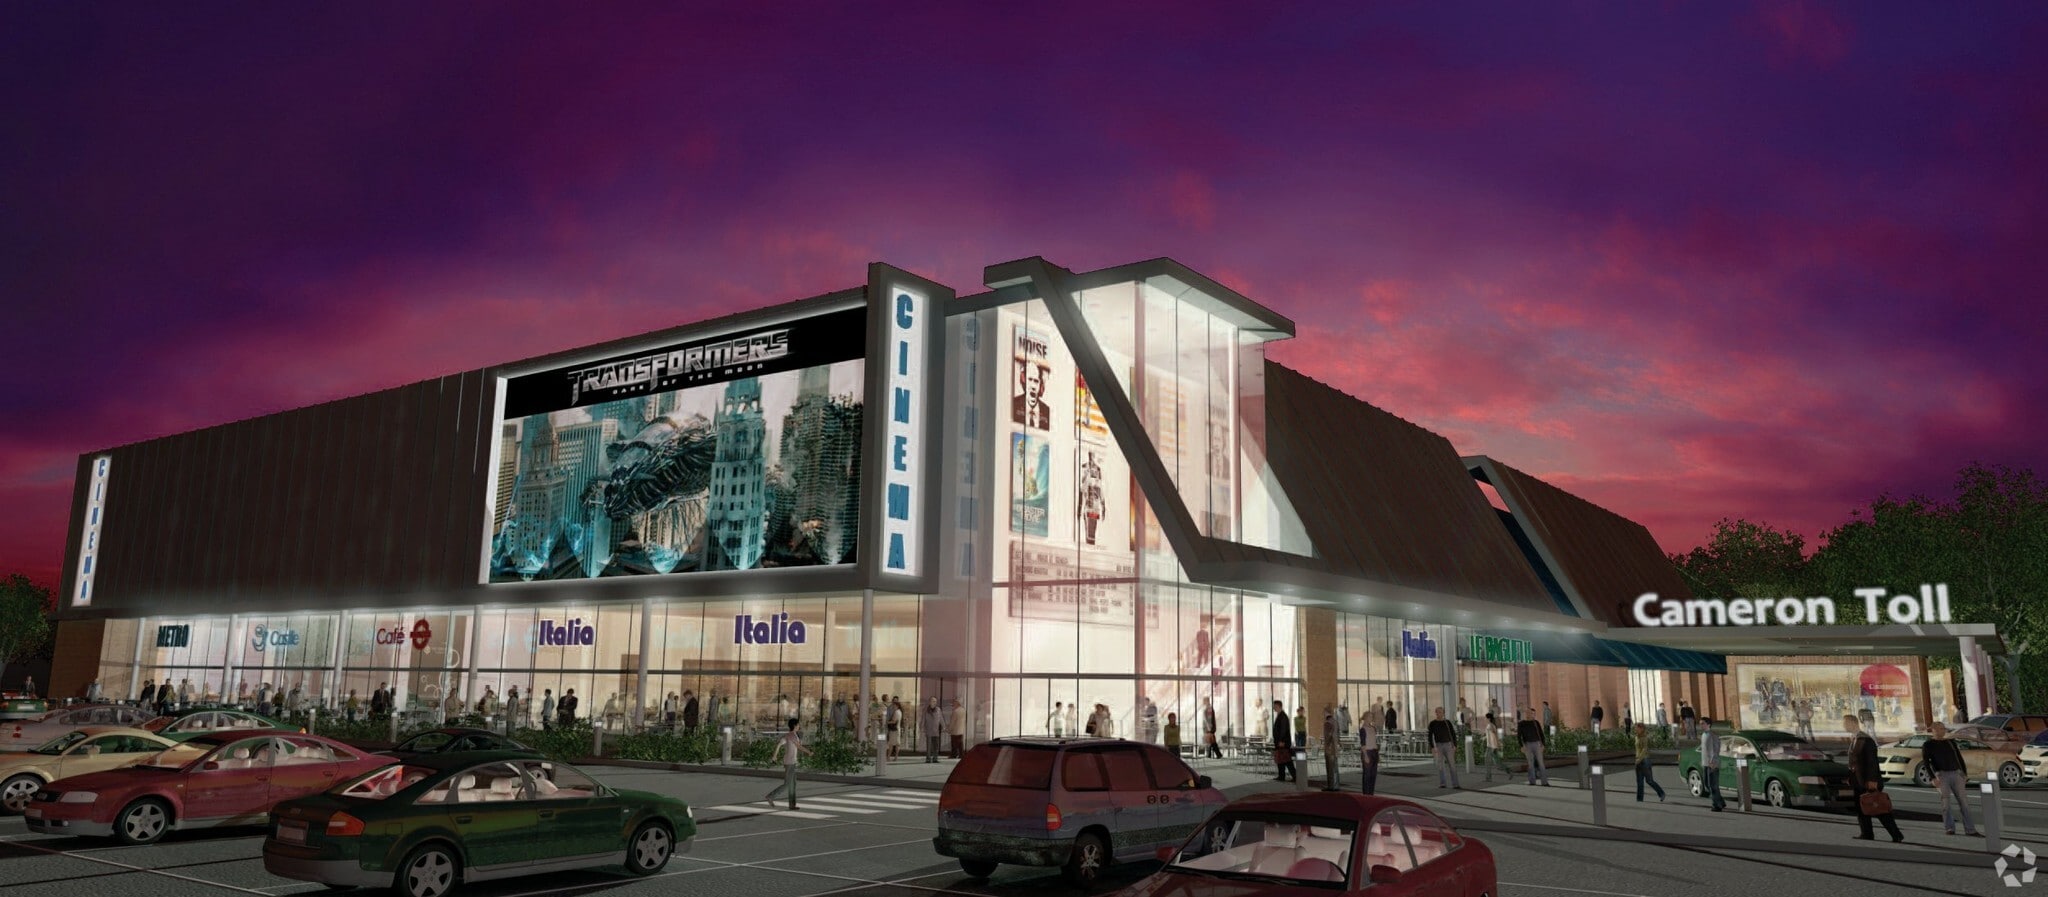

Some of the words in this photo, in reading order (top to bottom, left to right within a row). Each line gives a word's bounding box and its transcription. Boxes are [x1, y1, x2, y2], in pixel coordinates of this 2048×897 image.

[567, 328, 790, 407] TRANSFORMERS
[887, 293, 914, 570] CINEMA
[80, 459, 106, 600] CINEMA
[1633, 592, 1835, 626] Cameron
[1854, 583, 1951, 625] Toll
[157, 624, 189, 648] METRO
[376, 627, 405, 645] Café
[538, 618, 594, 646] Italia
[734, 612, 806, 644] Italia
